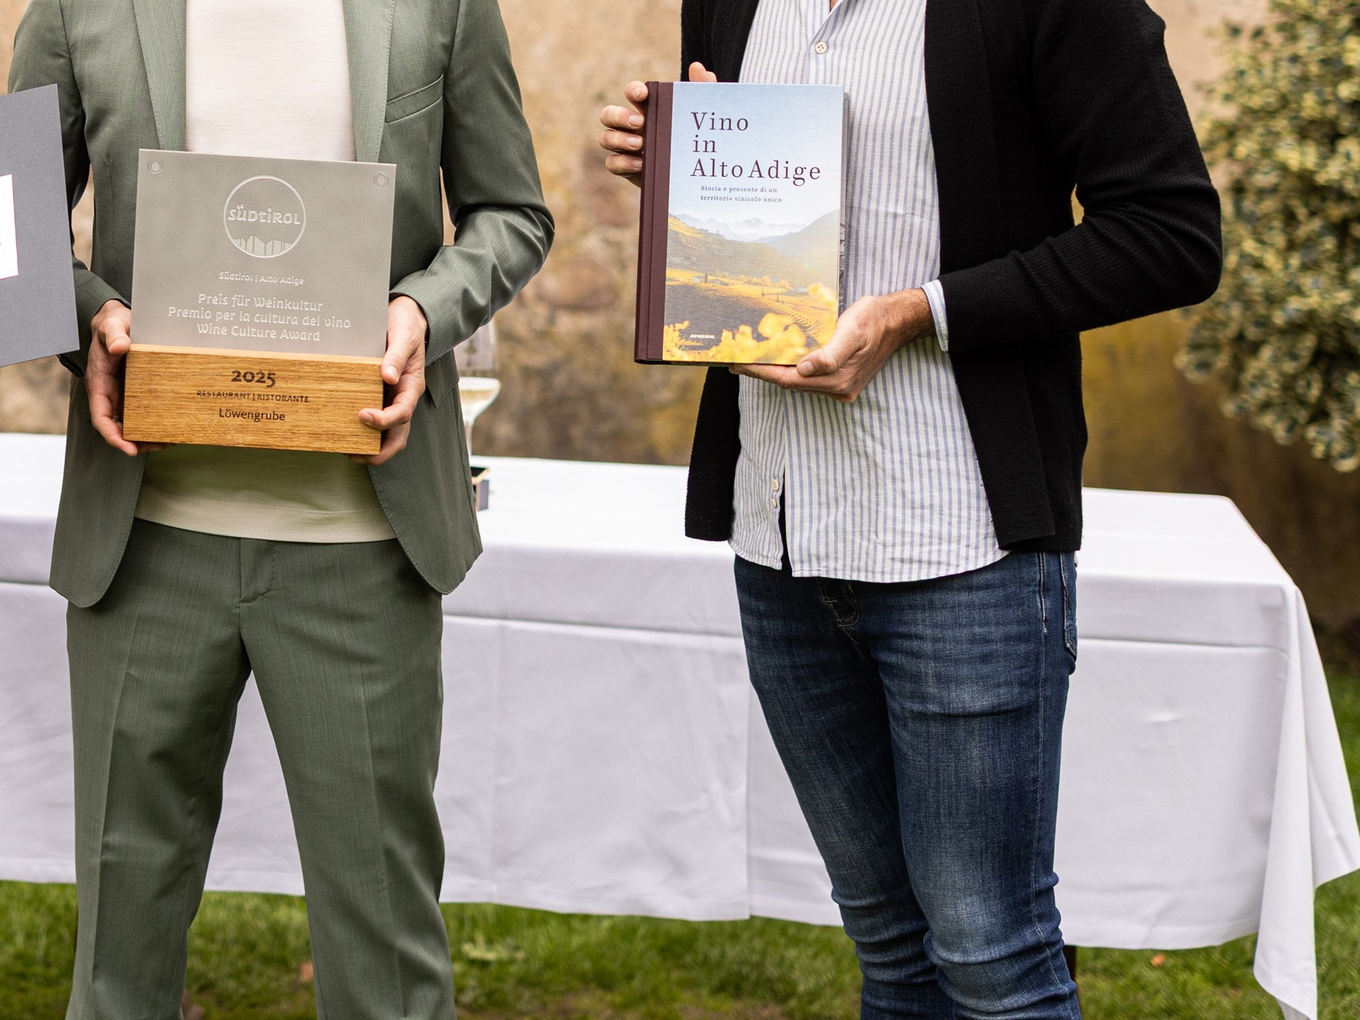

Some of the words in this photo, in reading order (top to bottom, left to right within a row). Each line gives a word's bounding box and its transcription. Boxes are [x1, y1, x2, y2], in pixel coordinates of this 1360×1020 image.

[690, 111, 749, 131] Vino
[693, 134, 717, 153] in
[690, 158, 743, 178] Alto
[747, 159, 821, 187] Adige
[700, 194, 733, 202] territorio
[729, 186, 758, 194] presente
[218, 271, 253, 282] Südtirol
[259, 275, 278, 283] Alto
[279, 276, 304, 286] Adige
[198, 293, 228, 306] Preis
[231, 295, 250, 308] für
[253, 297, 324, 312] Weinkultur
[168, 306, 212, 320] Premio
[215, 311, 236, 322] per
[240, 311, 251, 322] la
[254, 313, 299, 325] cultura
[302, 315, 321, 327] del
[323, 315, 352, 329] vino
[196, 323, 228, 336] Wine
[231, 325, 277, 339] Culture
[279, 329, 321, 342] Award
[231, 370, 277, 388] 2025
[196, 390, 251, 400] RESTAURANT
[257, 393, 310, 403] RISTORANTE
[219, 408, 286, 423] Löwengrube
